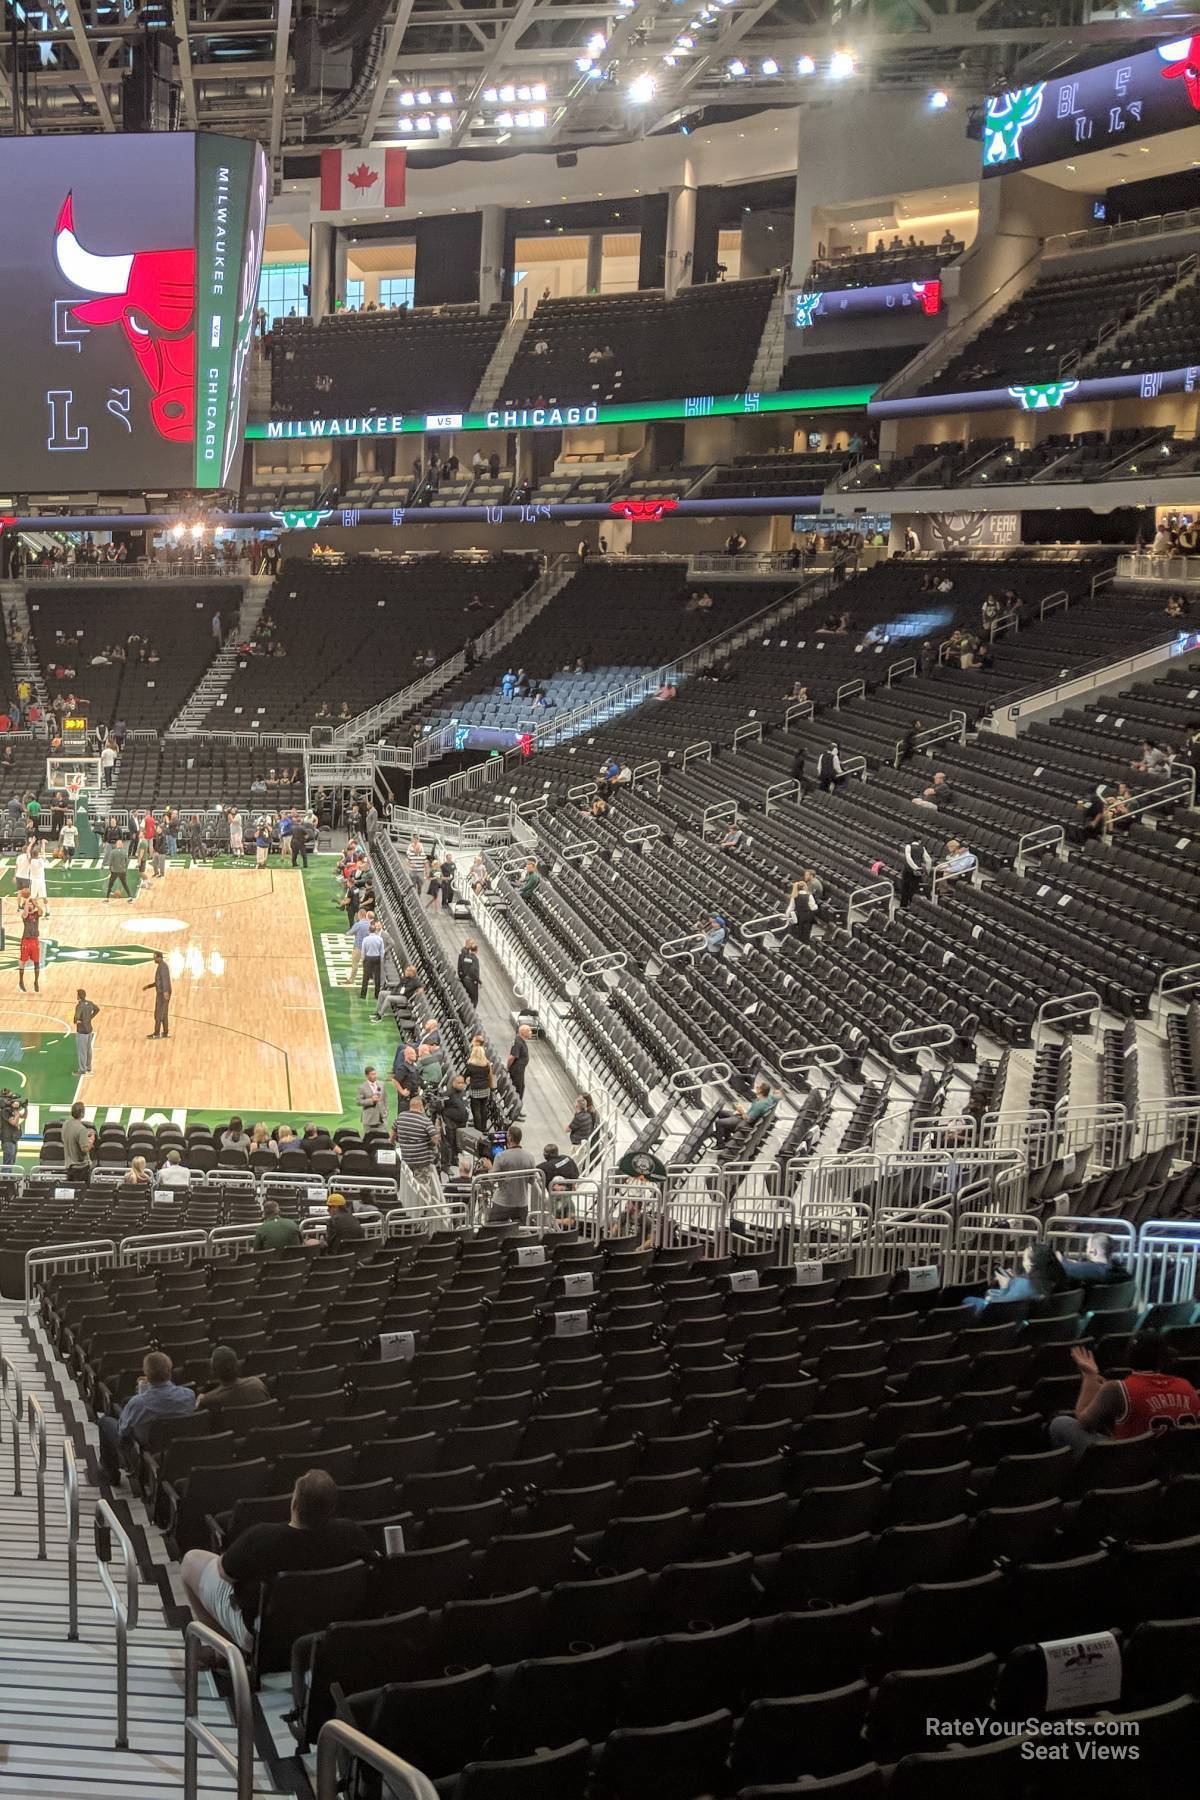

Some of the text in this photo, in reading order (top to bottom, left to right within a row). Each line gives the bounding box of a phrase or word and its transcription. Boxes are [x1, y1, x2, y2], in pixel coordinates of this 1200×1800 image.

[212, 167, 230, 296] MILWAUKEE
[204, 368, 219, 460] CHICAGO
[267, 406, 598, 438] MILWAUKEE VS CHICAGO
[990, 514, 1017, 532] FEAR
[1146, 1393, 1191, 1412] JORDAN
